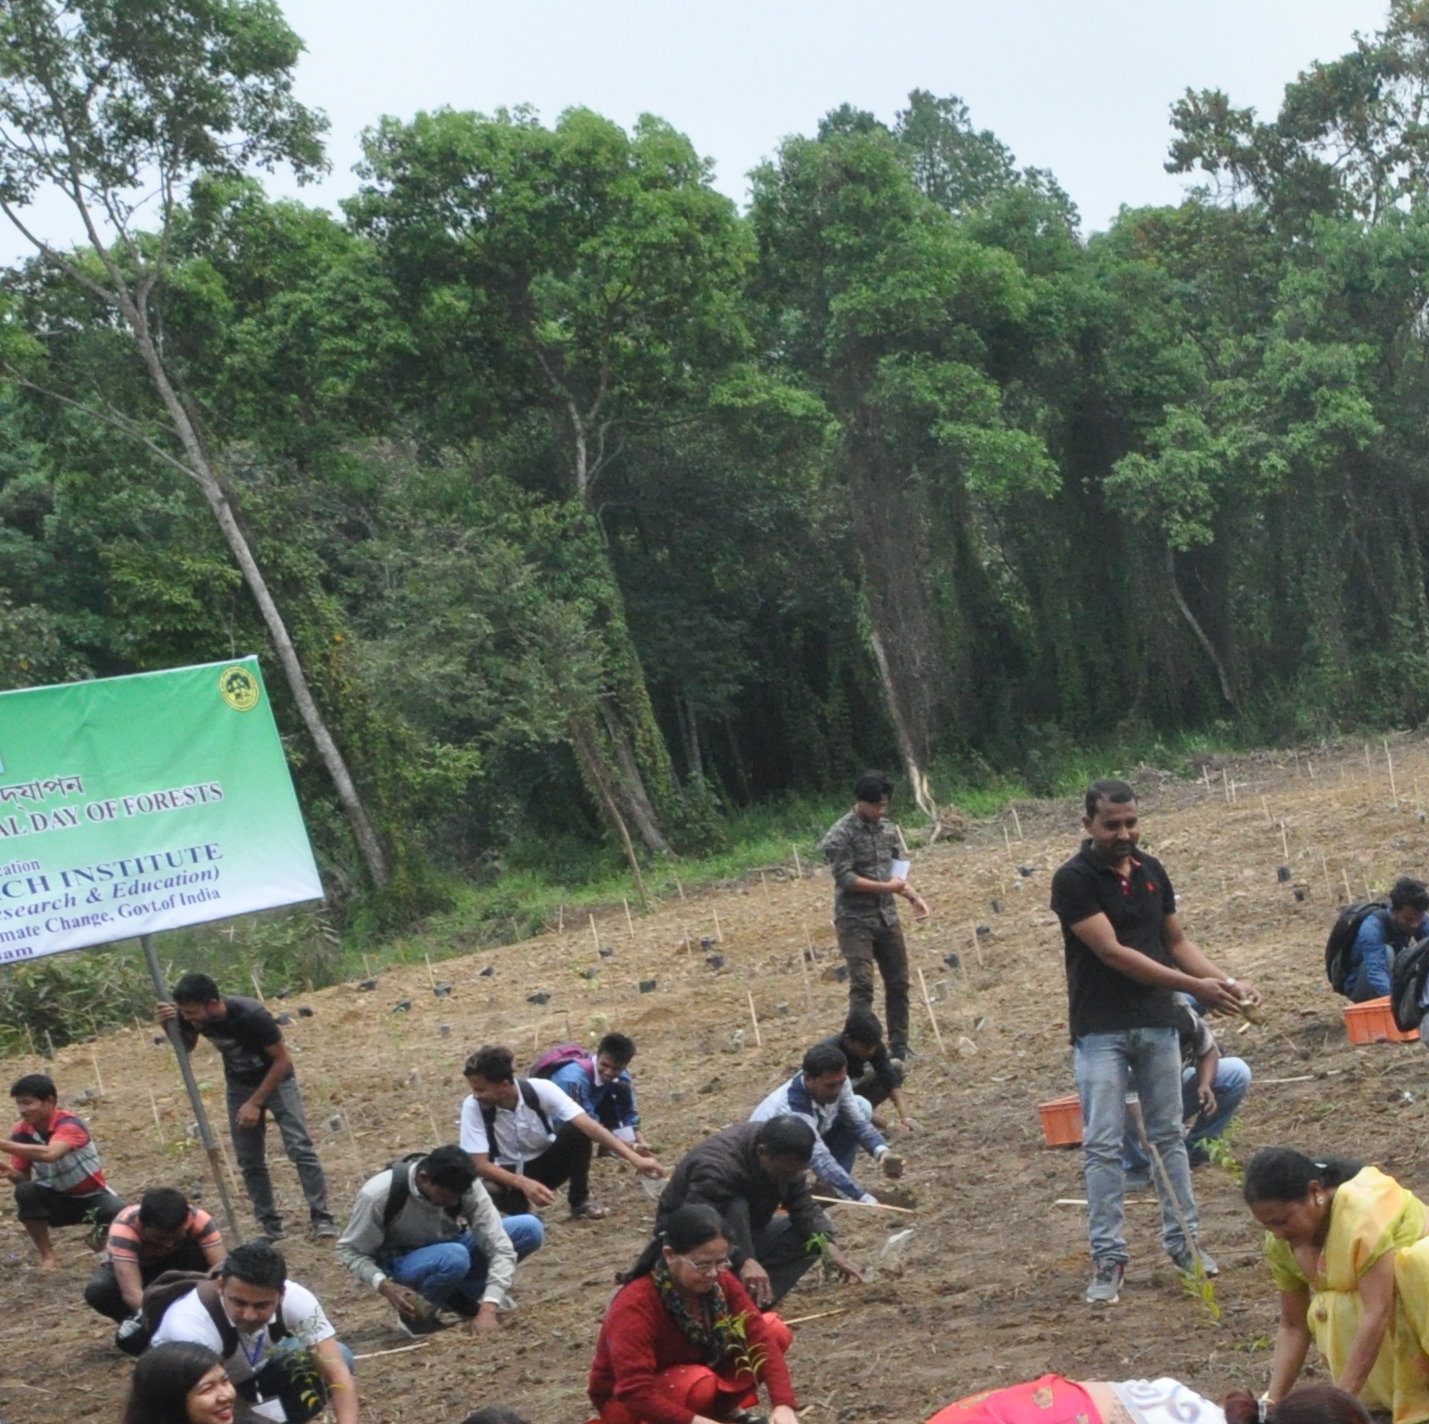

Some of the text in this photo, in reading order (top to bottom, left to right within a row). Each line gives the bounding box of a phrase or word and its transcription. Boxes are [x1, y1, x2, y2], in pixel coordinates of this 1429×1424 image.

[29, 807, 79, 832] DAY
[86, 800, 118, 822] OF
[122, 782, 223, 816] FORESTS
[0, 842, 223, 901] CH INSTITUTE
[85, 886, 104, 905] &
[112, 865, 220, 900] Education)
[45, 910, 115, 935] Change,
[179, 886, 221, 906] India
[0, 945, 34, 961] am
